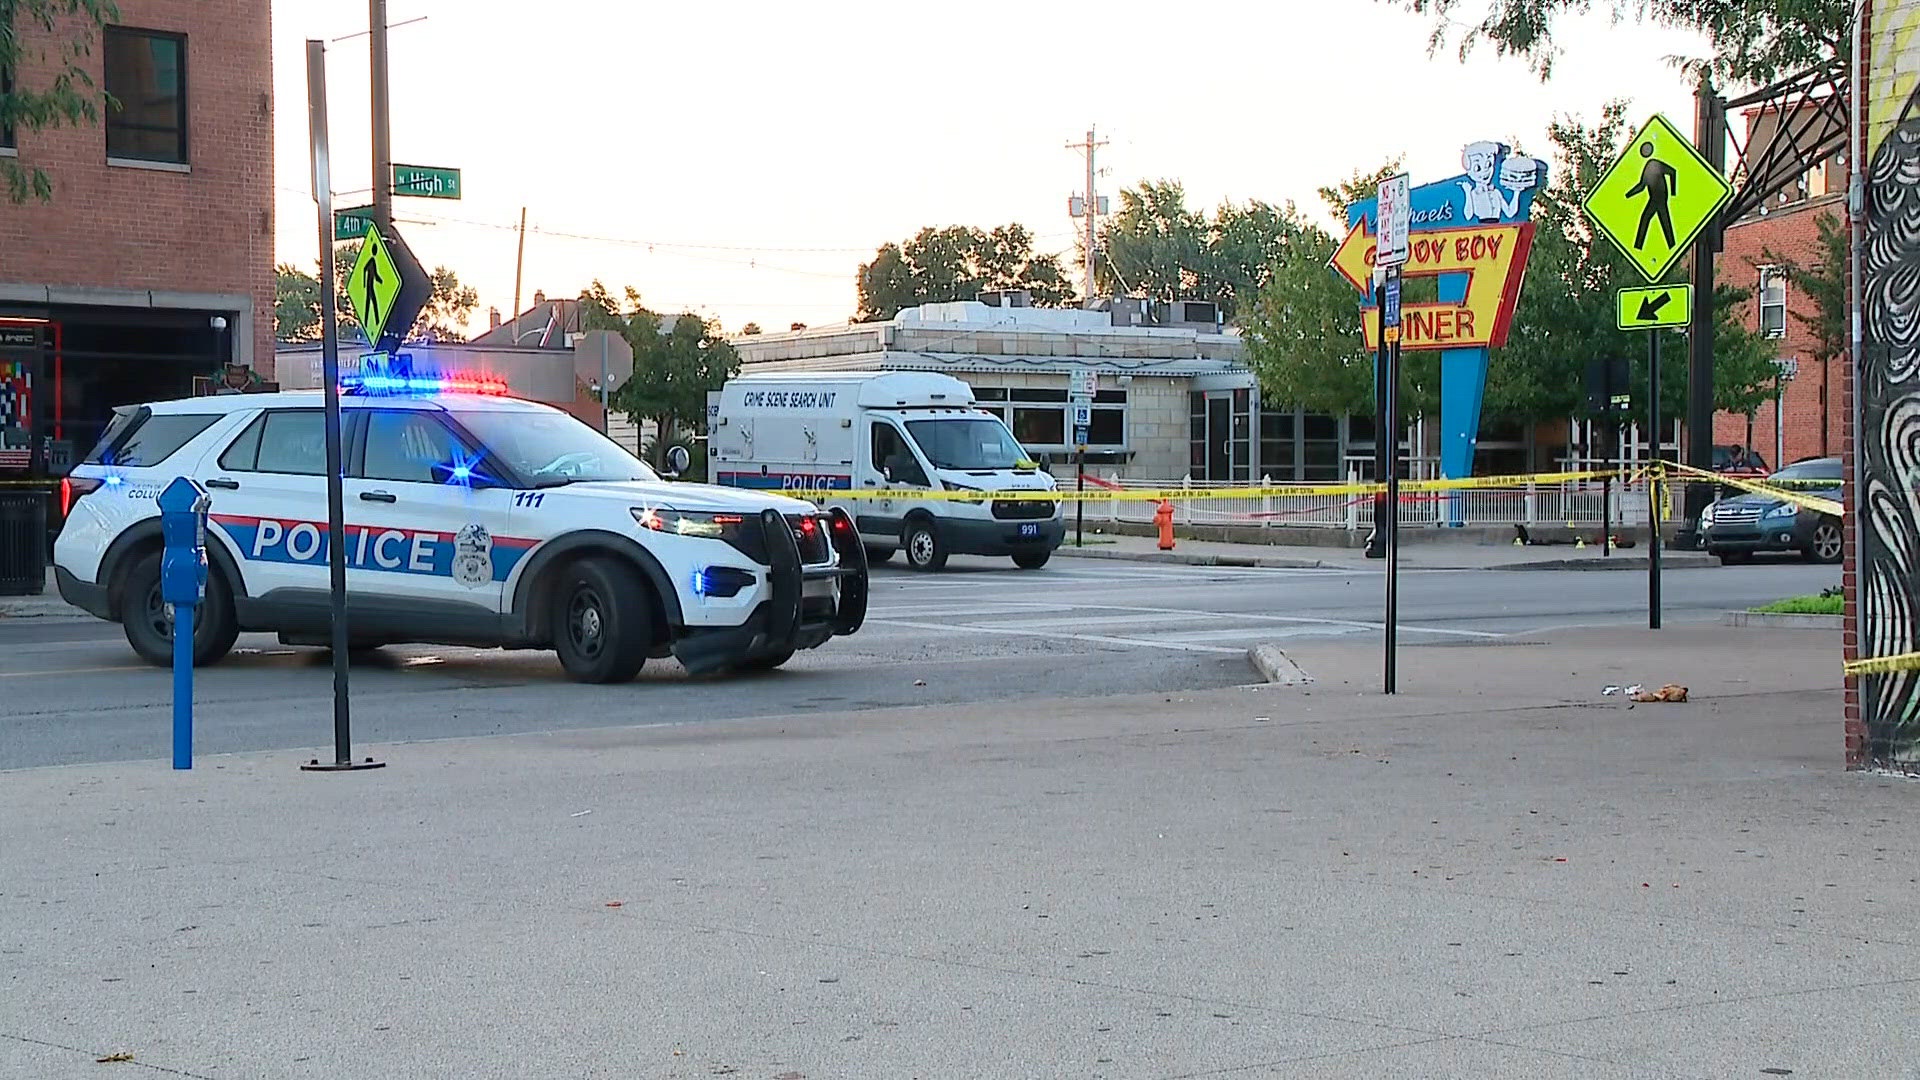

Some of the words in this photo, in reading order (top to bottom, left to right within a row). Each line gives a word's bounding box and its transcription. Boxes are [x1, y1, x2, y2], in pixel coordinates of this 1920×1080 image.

[410, 172, 443, 196] High
[447, 178, 456, 189] St
[343, 216, 360, 232] 4th
[1455, 234, 1503, 261] BOY
[744, 391, 765, 407] CRIME
[766, 391, 789, 408] SCENE
[789, 391, 817, 408] SEARCH
[818, 392, 836, 408] UNIT
[782, 475, 836, 490] POLICE
[515, 491, 545, 509] 111
[1021, 524, 1037, 535] 991
[252, 519, 439, 572] POICE
